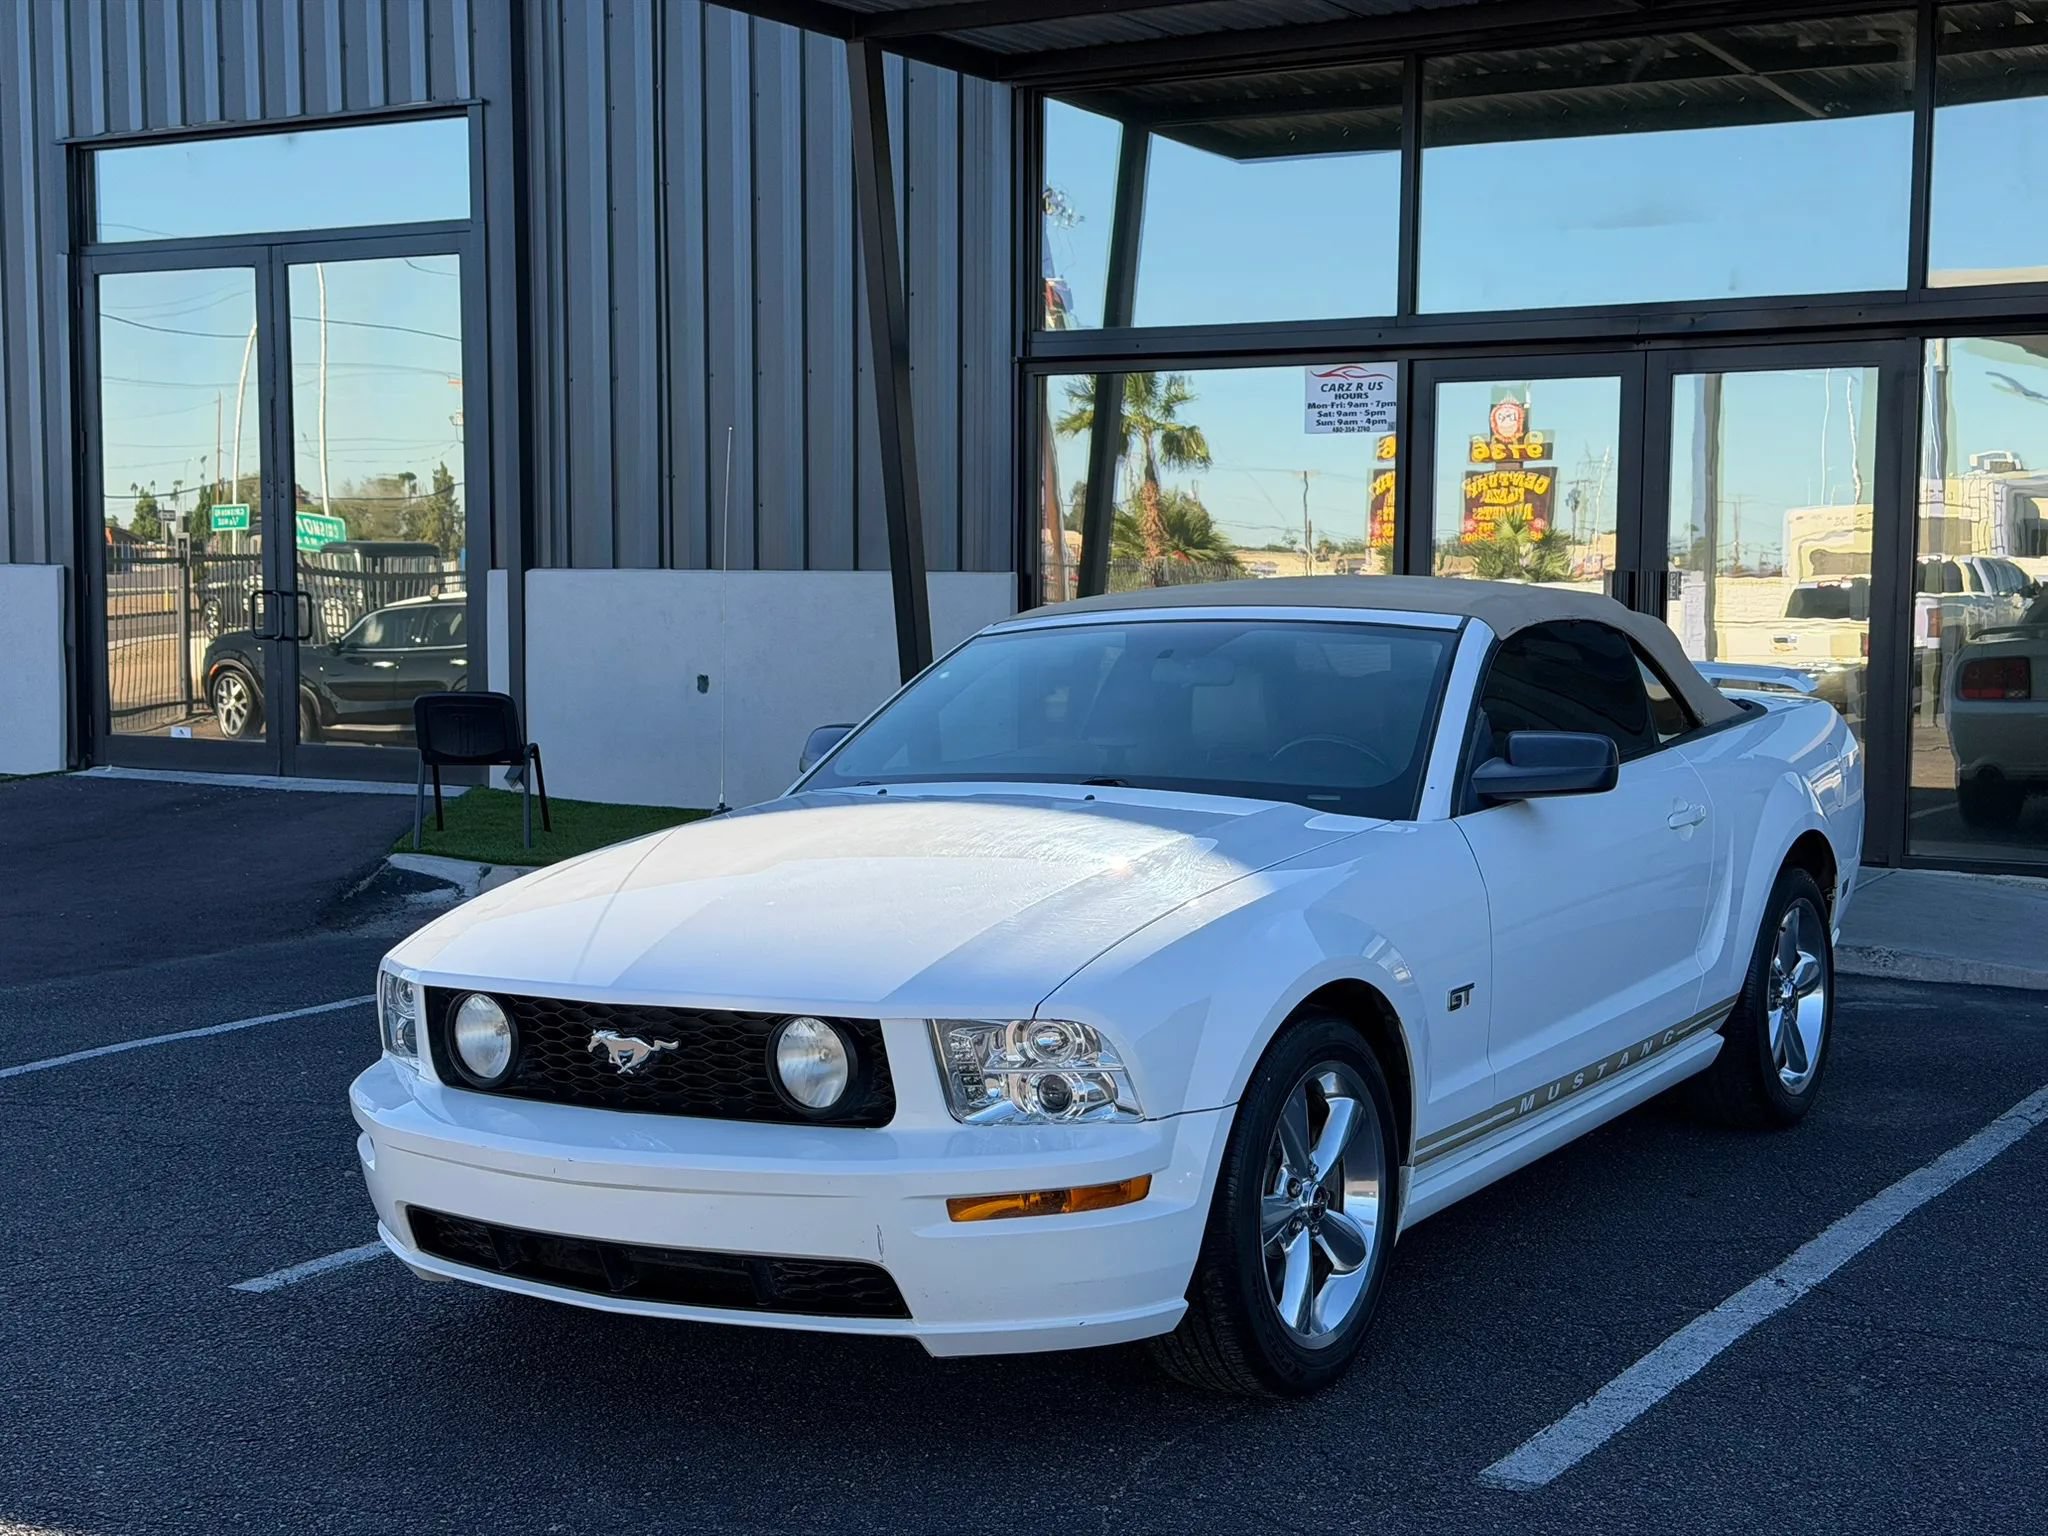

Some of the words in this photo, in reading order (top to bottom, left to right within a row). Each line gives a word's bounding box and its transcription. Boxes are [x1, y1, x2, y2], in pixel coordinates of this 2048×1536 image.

[1320, 382, 1353, 393] CARZ
[1355, 382, 1364, 392] R
[1367, 381, 1384, 391] US
[1334, 392, 1369, 400] HOURS
[1307, 401, 1346, 409] Mon-Fri:
[1375, 400, 1397, 408] 7pm
[1317, 410, 1335, 418] Sat:
[1364, 409, 1386, 417] 5pm
[1365, 418, 1388, 426] 4pm
[1447, 982, 1475, 1012] GT
[1518, 1029, 1674, 1114] MUSTANG
